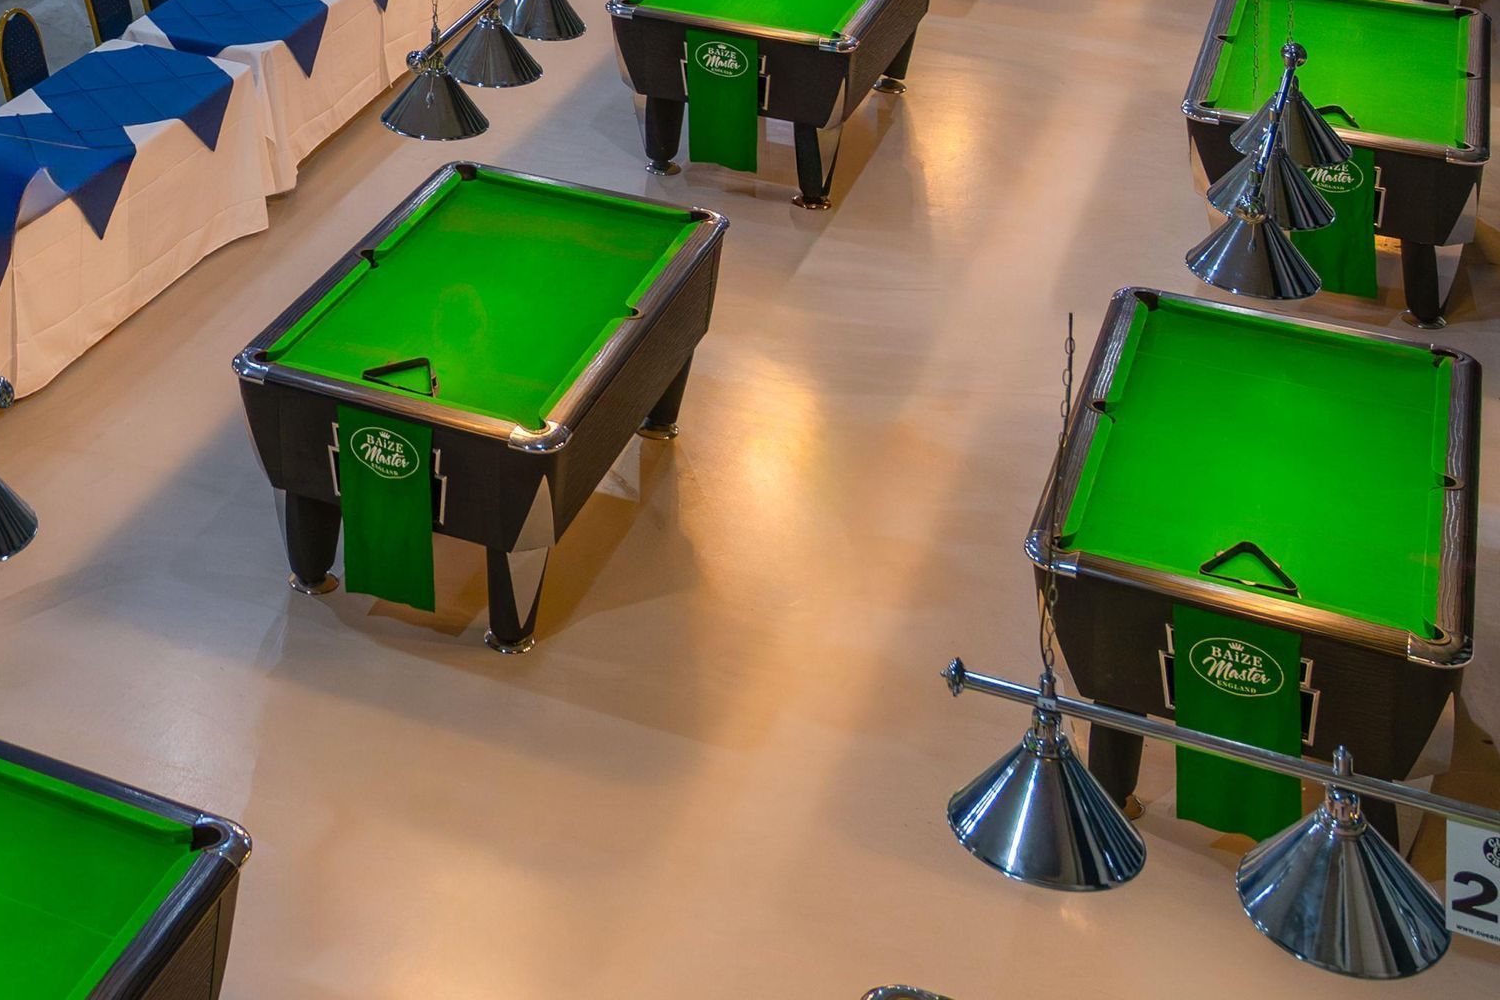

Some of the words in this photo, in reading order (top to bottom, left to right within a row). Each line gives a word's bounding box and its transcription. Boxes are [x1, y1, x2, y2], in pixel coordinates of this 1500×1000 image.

[703, 54, 741, 69] Master
[708, 47, 736, 60] BAiZE
[1307, 167, 1354, 184] Master
[366, 433, 404, 453] BAiZE
[360, 443, 410, 468] Master
[1211, 646, 1263, 668] BAiZE
[1202, 656, 1271, 684] Master
[1217, 680, 1257, 694] ENGLAND
